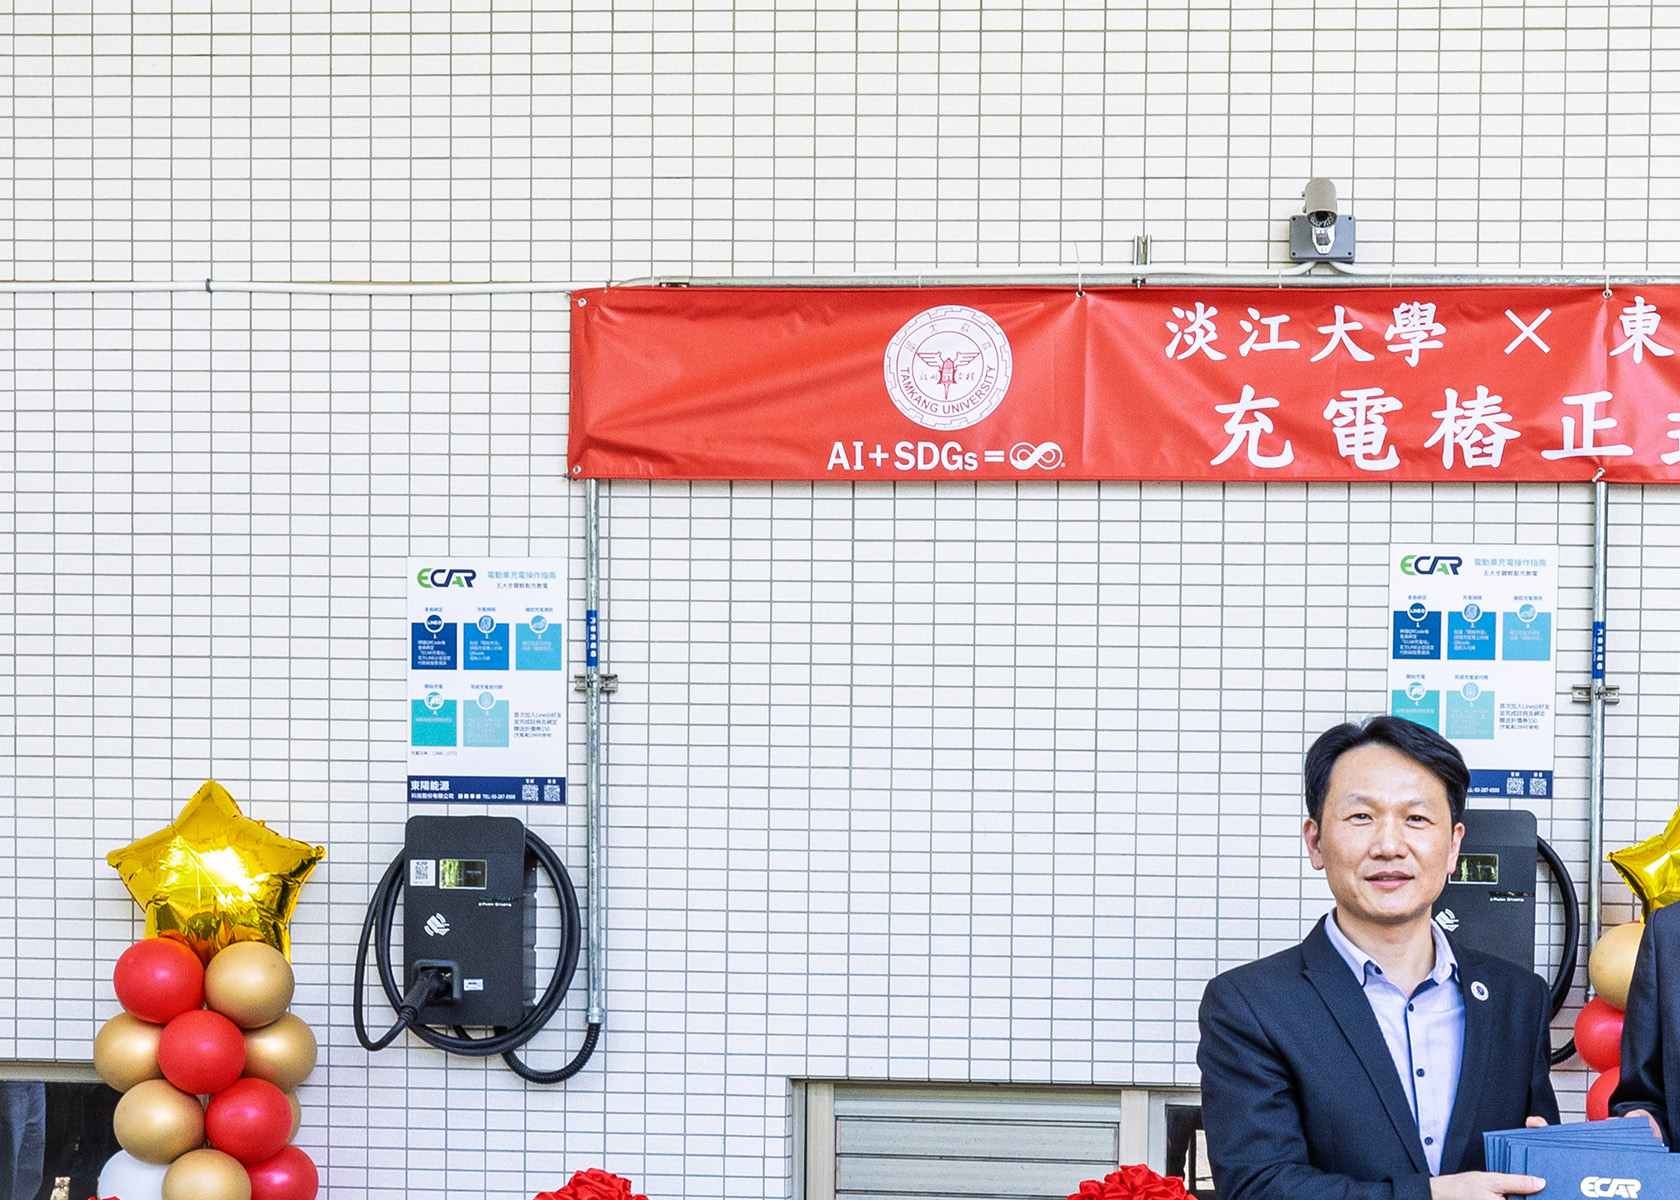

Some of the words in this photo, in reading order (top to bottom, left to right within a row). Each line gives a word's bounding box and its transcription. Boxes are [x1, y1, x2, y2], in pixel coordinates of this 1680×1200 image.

[1165, 301, 1447, 367] 淡江大學
[900, 367, 939, 414] TAMKANG
[942, 365, 996, 415] UNIVERSITY
[1400, 554, 1463, 576] ECAR
[417, 567, 477, 589] ECAR
[410, 780, 450, 791] 東陽能源
[1580, 1175, 1642, 1199] ECAR
